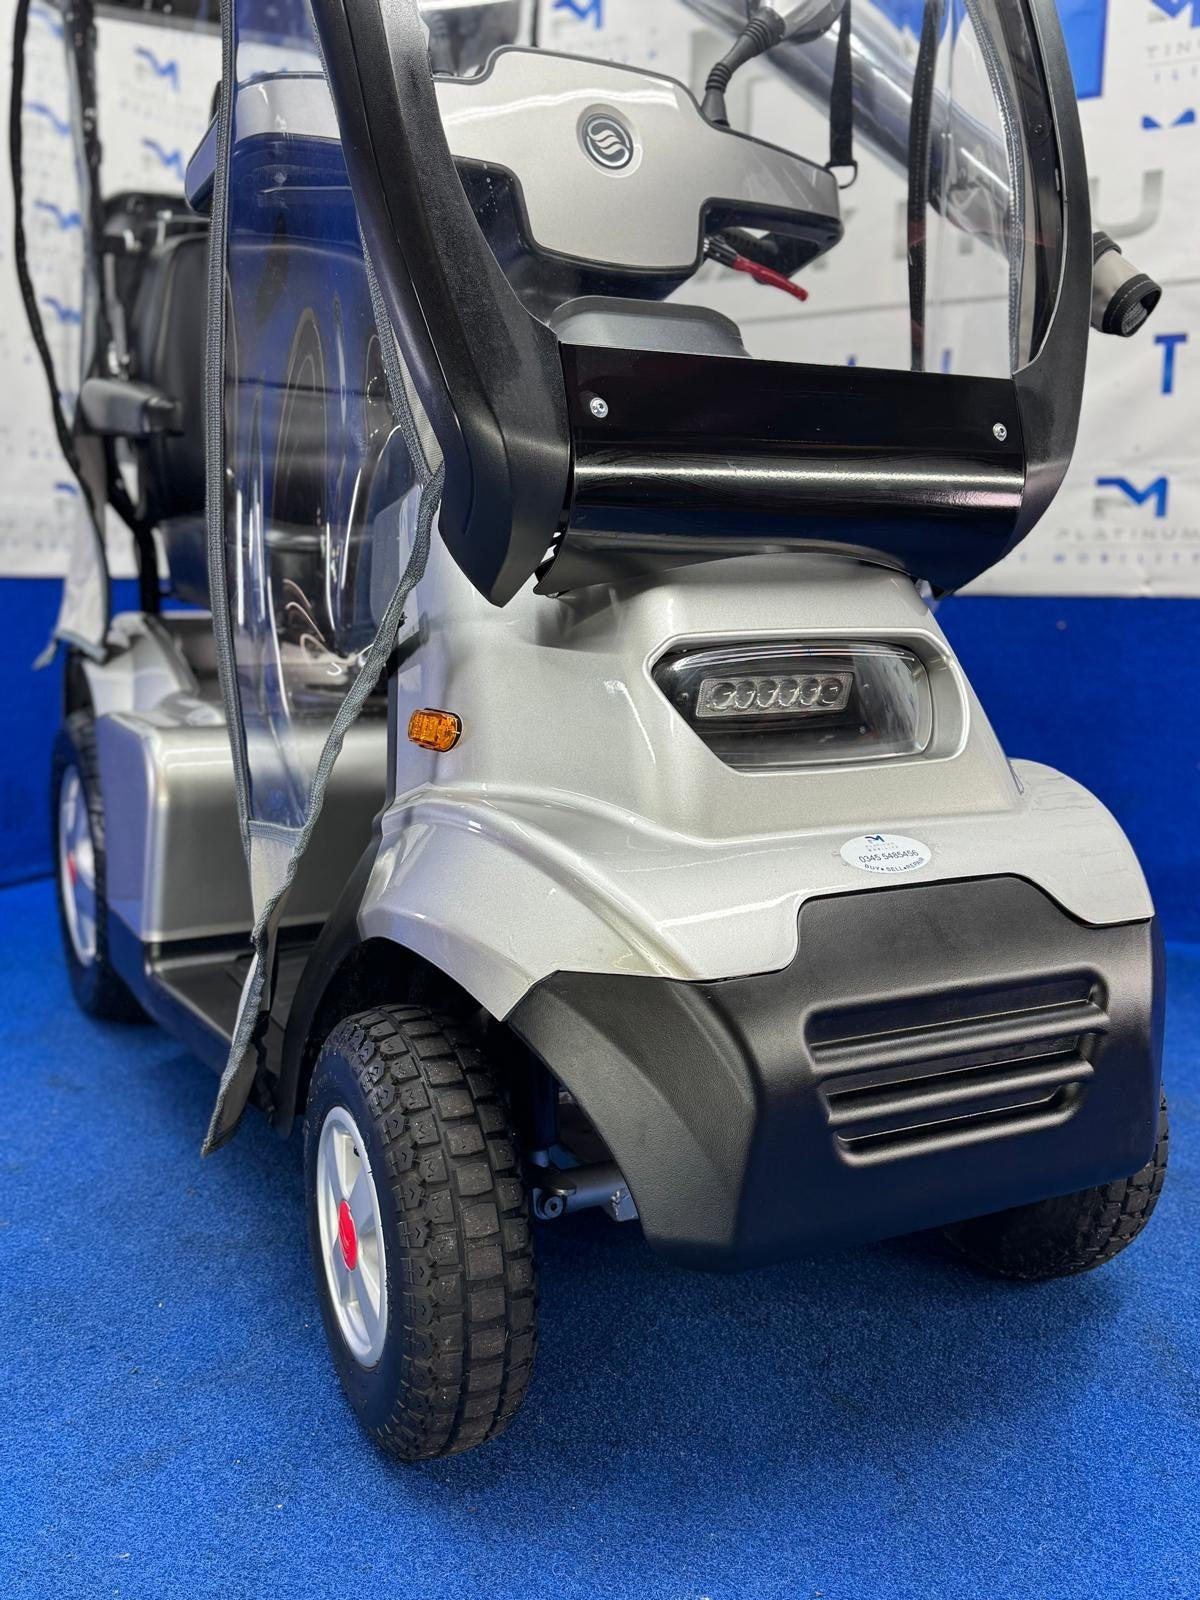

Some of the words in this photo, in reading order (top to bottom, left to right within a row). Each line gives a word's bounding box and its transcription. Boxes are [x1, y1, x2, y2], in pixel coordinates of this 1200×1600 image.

[859, 854, 881, 863] 0345
[882, 850, 919, 860] 5485456
[906, 857, 924, 869] REPAIR
